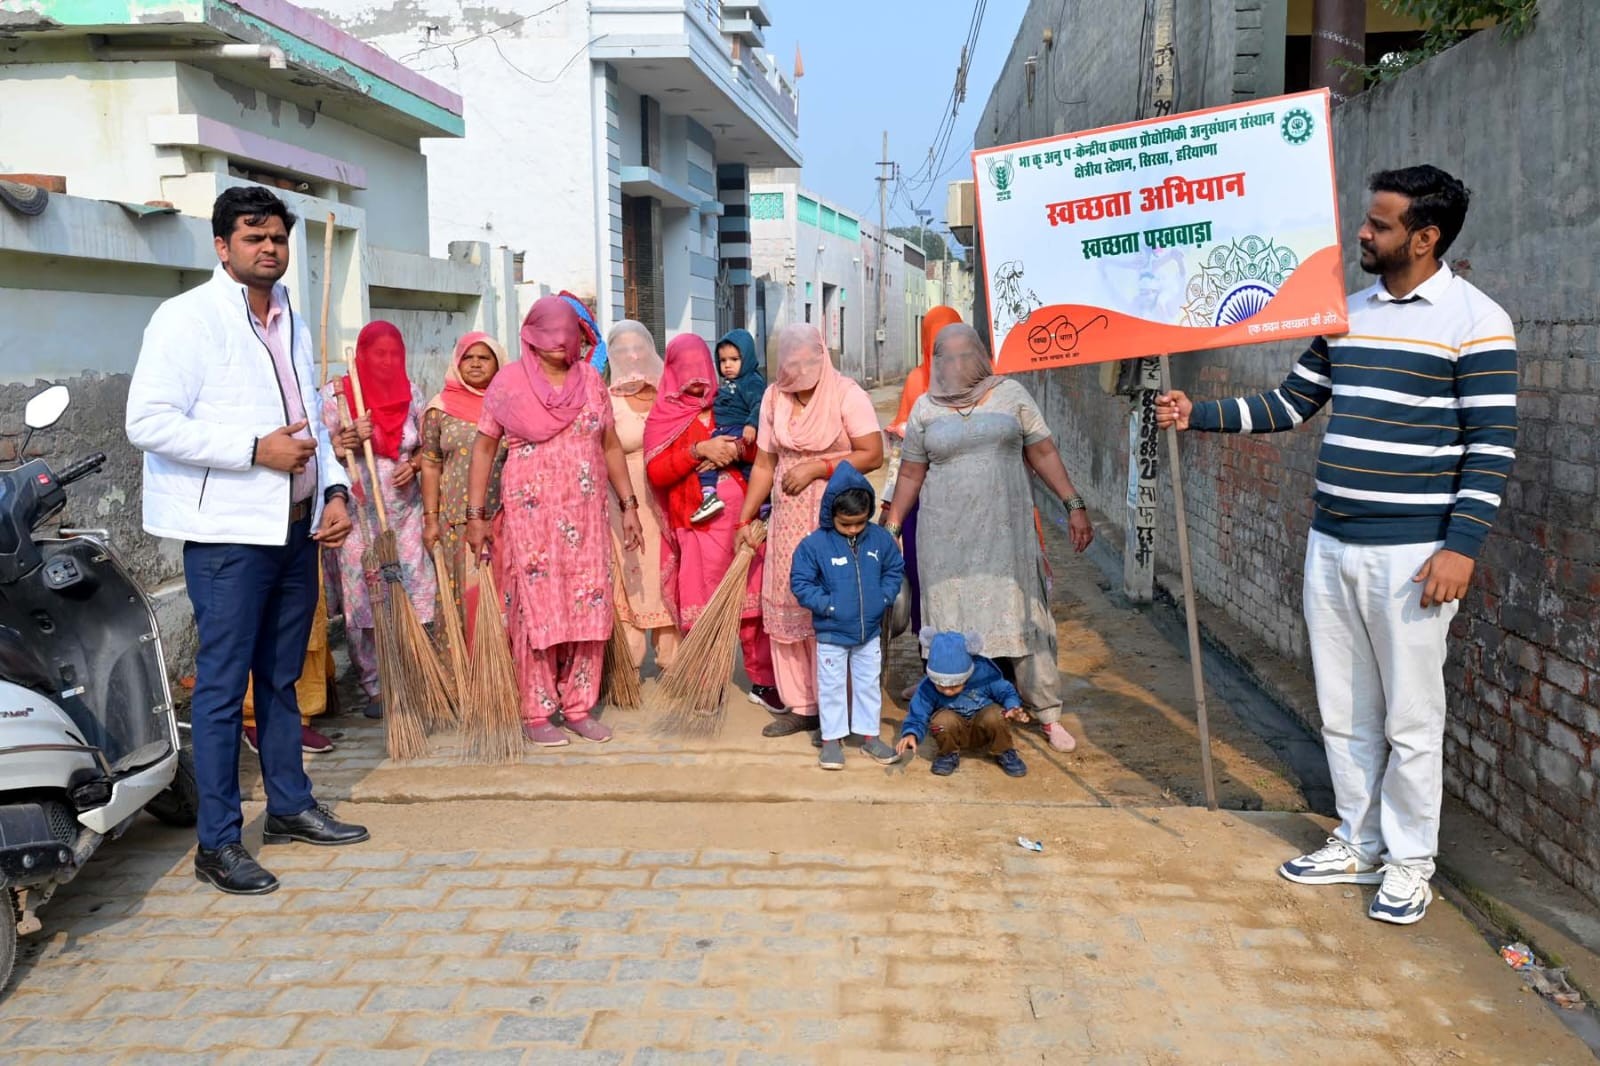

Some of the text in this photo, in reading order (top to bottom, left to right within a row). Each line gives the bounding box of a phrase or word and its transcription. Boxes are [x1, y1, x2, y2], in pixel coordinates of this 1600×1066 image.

[1019, 155, 1031, 168] भा
[1032, 153, 1043, 169] कृ
[1044, 150, 1063, 166] अनु
[1109, 136, 1138, 152] कपास
[1190, 118, 1237, 140] अनुसंधान
[1240, 112, 1275, 129] संस्थान
[1074, 143, 1217, 178] क्षेत्रीय स्टेशन, सिरसा, हरियाणा
[1045, 172, 1246, 227] स्वच्छता अभियान
[1081, 221, 1213, 259] स्वच्छता पखवाड़ा
